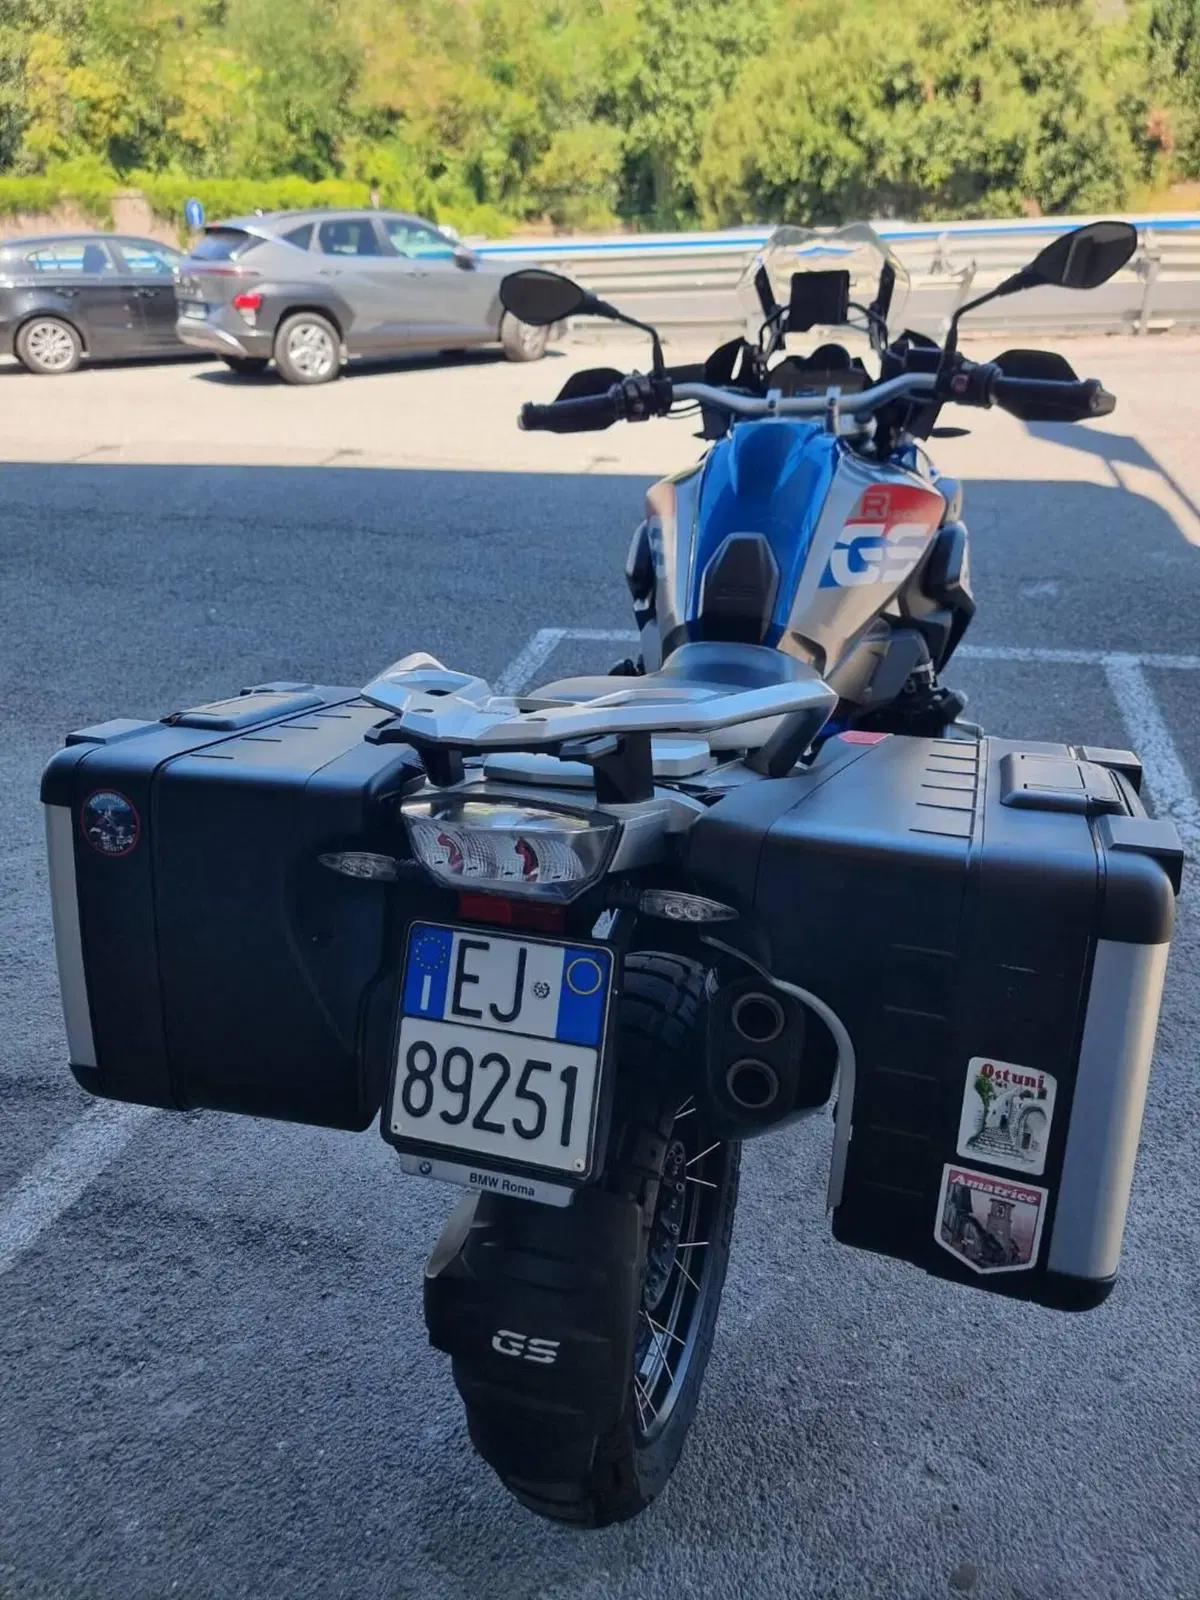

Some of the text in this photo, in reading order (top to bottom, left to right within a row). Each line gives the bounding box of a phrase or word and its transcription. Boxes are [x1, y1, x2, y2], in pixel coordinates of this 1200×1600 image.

[830, 523, 930, 586] GS
[451, 938, 528, 1023] EJ
[401, 1040, 579, 1148] 89251
[980, 1063, 1045, 1090] Ostuni
[469, 1172, 536, 1197] BMW Roma
[951, 1174, 1038, 1204] Amatrice
[491, 1329, 560, 1364] GS
